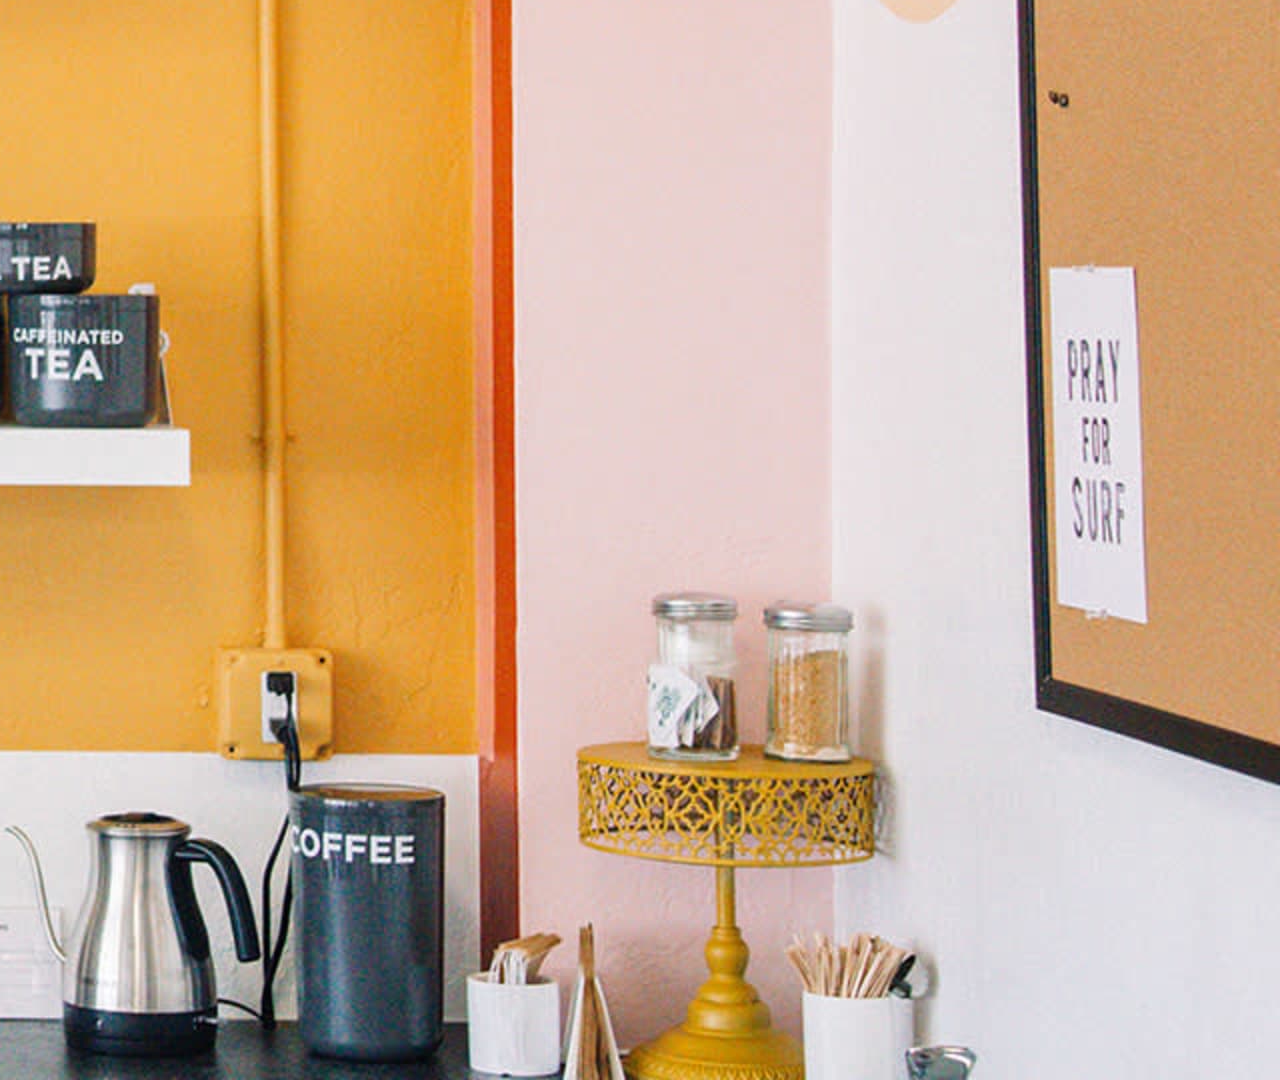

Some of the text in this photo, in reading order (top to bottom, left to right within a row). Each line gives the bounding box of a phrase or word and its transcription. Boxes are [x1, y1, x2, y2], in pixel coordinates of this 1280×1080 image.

[10, 255, 73, 281] TEA
[13, 327, 125, 345] CAFFEINATED
[25, 347, 104, 381] TEA
[1067, 338, 1120, 404] PRAY
[1081, 416, 1111, 465] FOR
[1071, 475, 1126, 545] SURF
[290, 824, 416, 865] COFFEE
